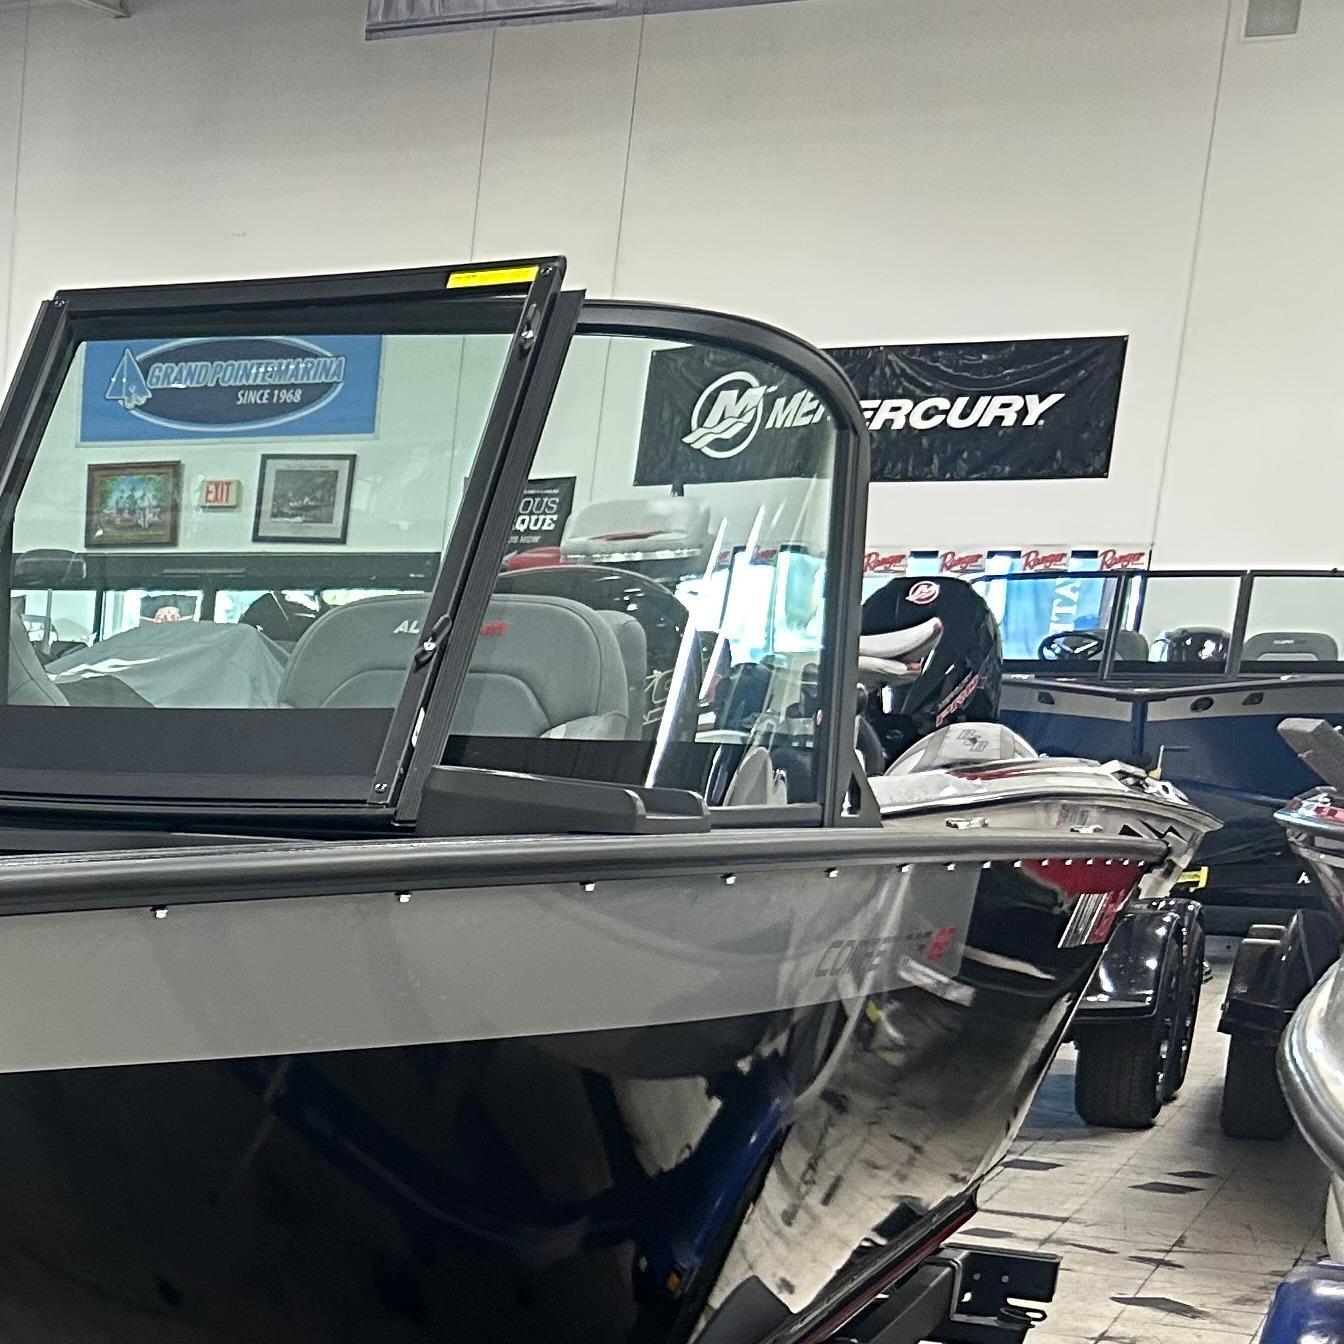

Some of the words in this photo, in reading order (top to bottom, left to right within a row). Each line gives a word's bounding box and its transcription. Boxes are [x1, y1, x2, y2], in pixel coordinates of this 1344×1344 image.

[147, 361, 212, 389] GRAND
[210, 357, 275, 387] POINTE
[271, 356, 346, 384] MARINA
[236, 389, 272, 405] SINCE
[273, 387, 302, 404] 1968
[205, 481, 233, 504] EXIT
[513, 515, 559, 532] QUE
[863, 551, 906, 571] Ranger
[940, 551, 984, 571] Ranger
[1021, 549, 1067, 570] Ranger
[1098, 549, 1146, 570] Ranger
